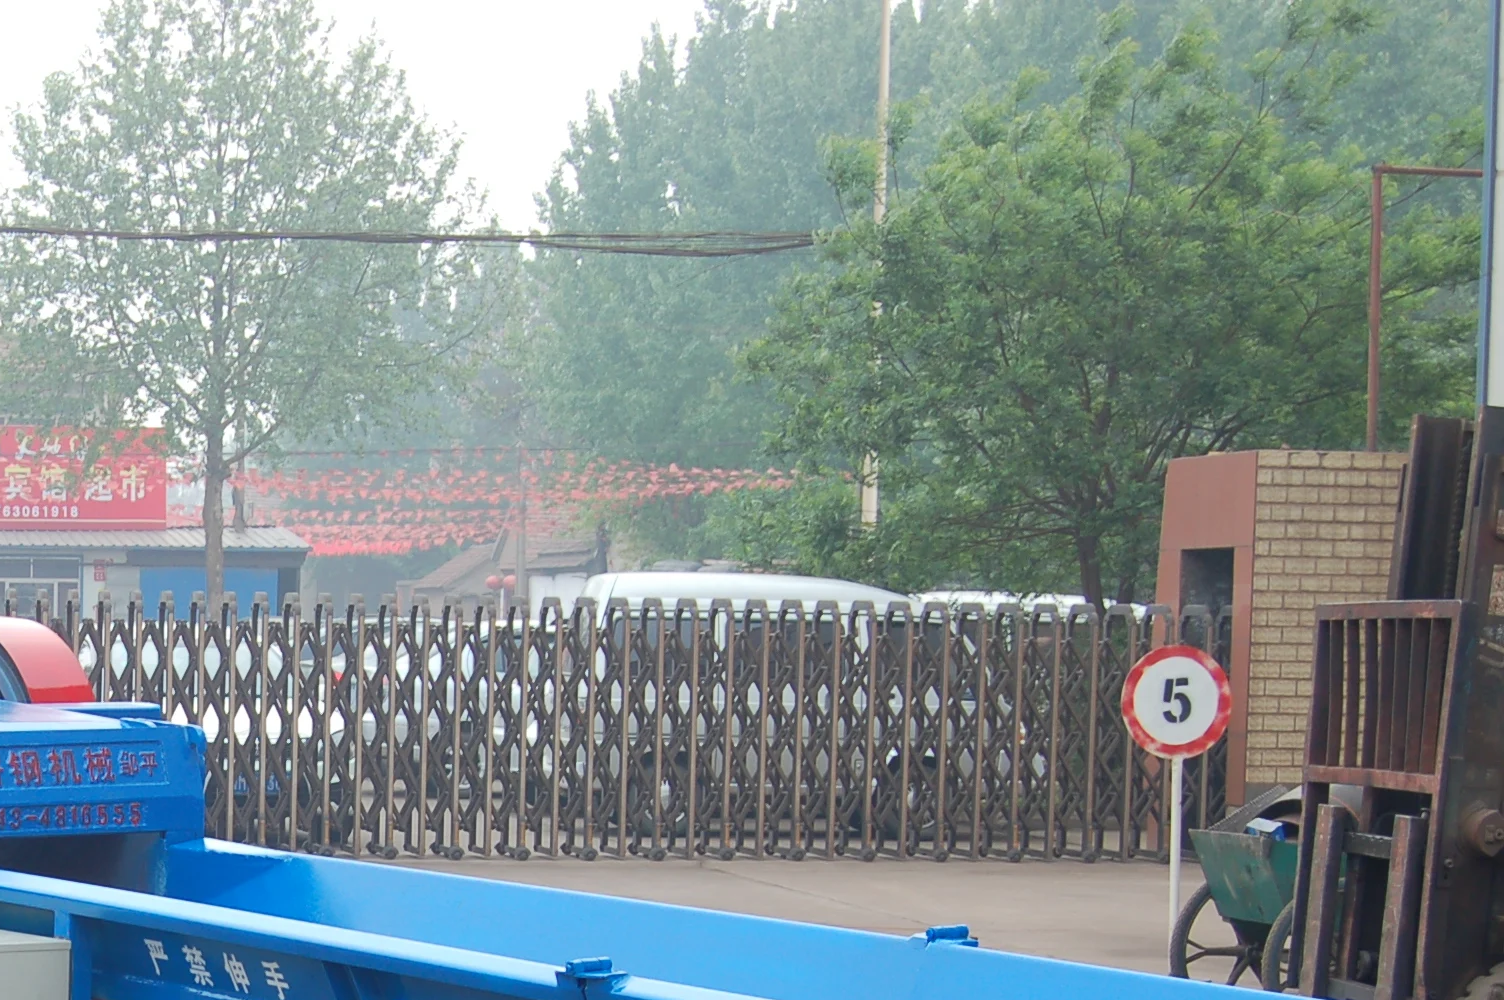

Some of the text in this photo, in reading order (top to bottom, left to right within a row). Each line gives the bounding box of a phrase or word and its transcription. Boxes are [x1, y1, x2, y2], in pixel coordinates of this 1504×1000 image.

[1162, 677, 1192, 724] 5
[143, 938, 291, 1000] 严禁伸手
